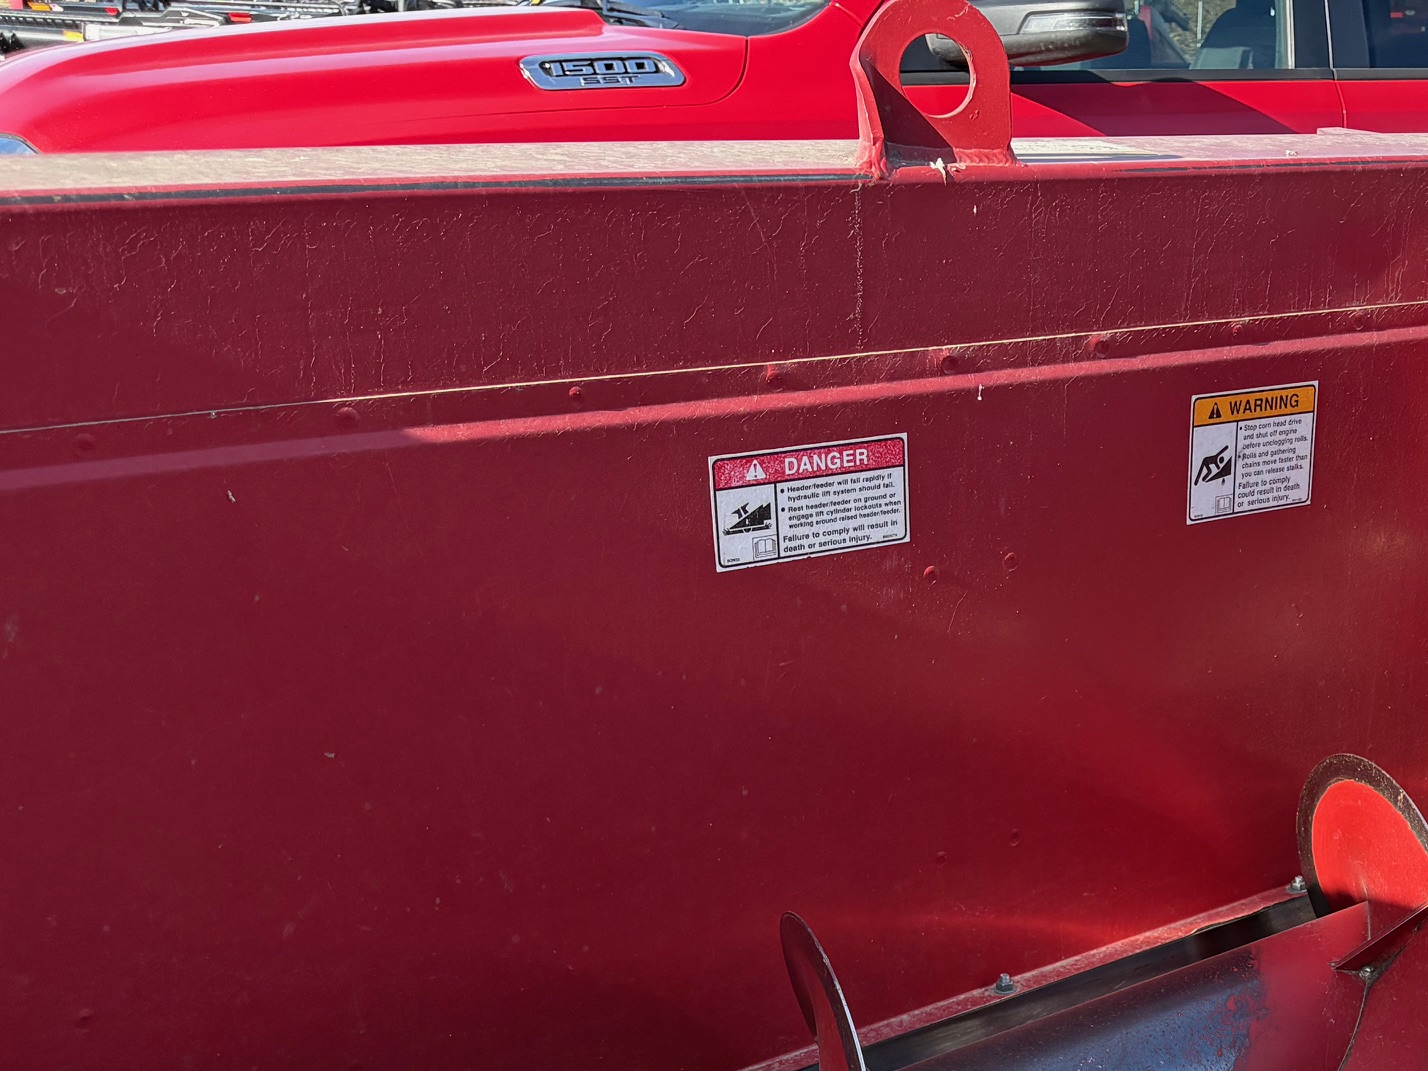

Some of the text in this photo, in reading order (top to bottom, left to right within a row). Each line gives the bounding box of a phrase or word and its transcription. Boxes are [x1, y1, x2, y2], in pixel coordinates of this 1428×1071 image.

[550, 58, 657, 77] 1500
[581, 74, 640, 86] SST
[1229, 393, 1299, 416] WARNING
[1273, 420, 1286, 428] head
[1256, 431, 1268, 439] shut
[1279, 428, 1297, 436] engine
[1263, 437, 1293, 446] unclogging
[1270, 447, 1296, 457] gathering
[784, 448, 868, 475] DANGER
[862, 474, 885, 484] rapidly
[1238, 481, 1259, 489] Failure
[1269, 476, 1291, 485] comply
[788, 493, 820, 502] hydraulic
[833, 488, 856, 498] system
[858, 484, 880, 492] should
[1238, 490, 1255, 498] could
[1257, 487, 1274, 495] result
[1283, 483, 1300, 491] death
[864, 493, 887, 503] ground
[1248, 498, 1270, 506] serious
[789, 513, 813, 521] engage
[815, 509, 824, 517] lift
[826, 507, 852, 516] cylinder
[854, 503, 882, 511] lockouts
[789, 521, 813, 529] working
[839, 514, 857, 522] raised
[783, 534, 810, 543] Failure
[823, 527, 850, 537] comply
[868, 521, 888, 530] result
[784, 544, 805, 553] death
[819, 538, 846, 547] serious
